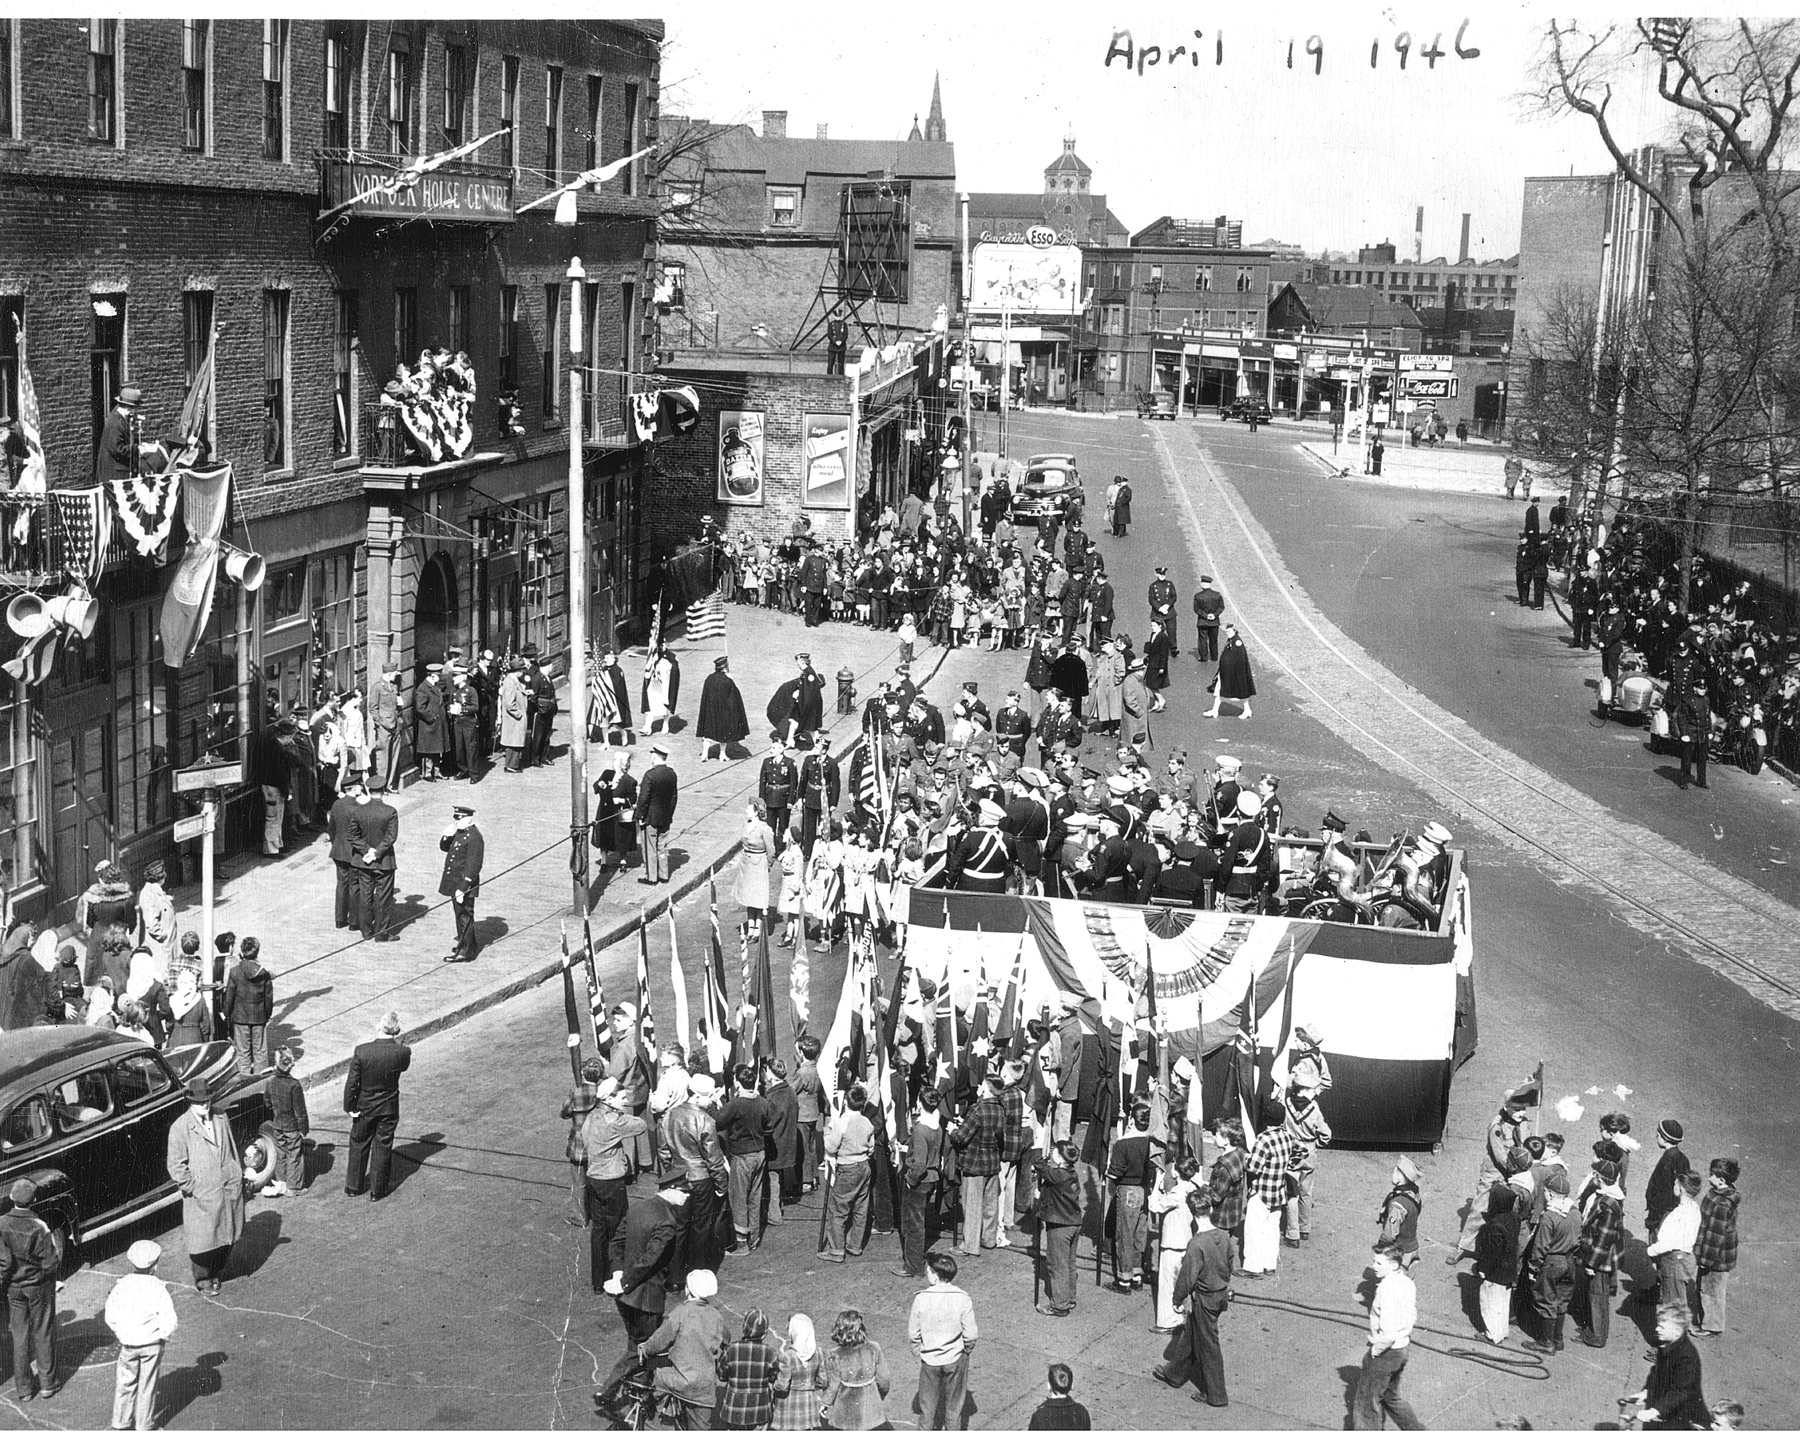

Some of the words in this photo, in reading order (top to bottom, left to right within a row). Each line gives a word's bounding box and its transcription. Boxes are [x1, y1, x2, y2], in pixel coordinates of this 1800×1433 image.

[422, 179, 460, 209] HOUSE
[466, 182, 511, 212] CENTRE
[811, 426, 829, 436] Enjoy
